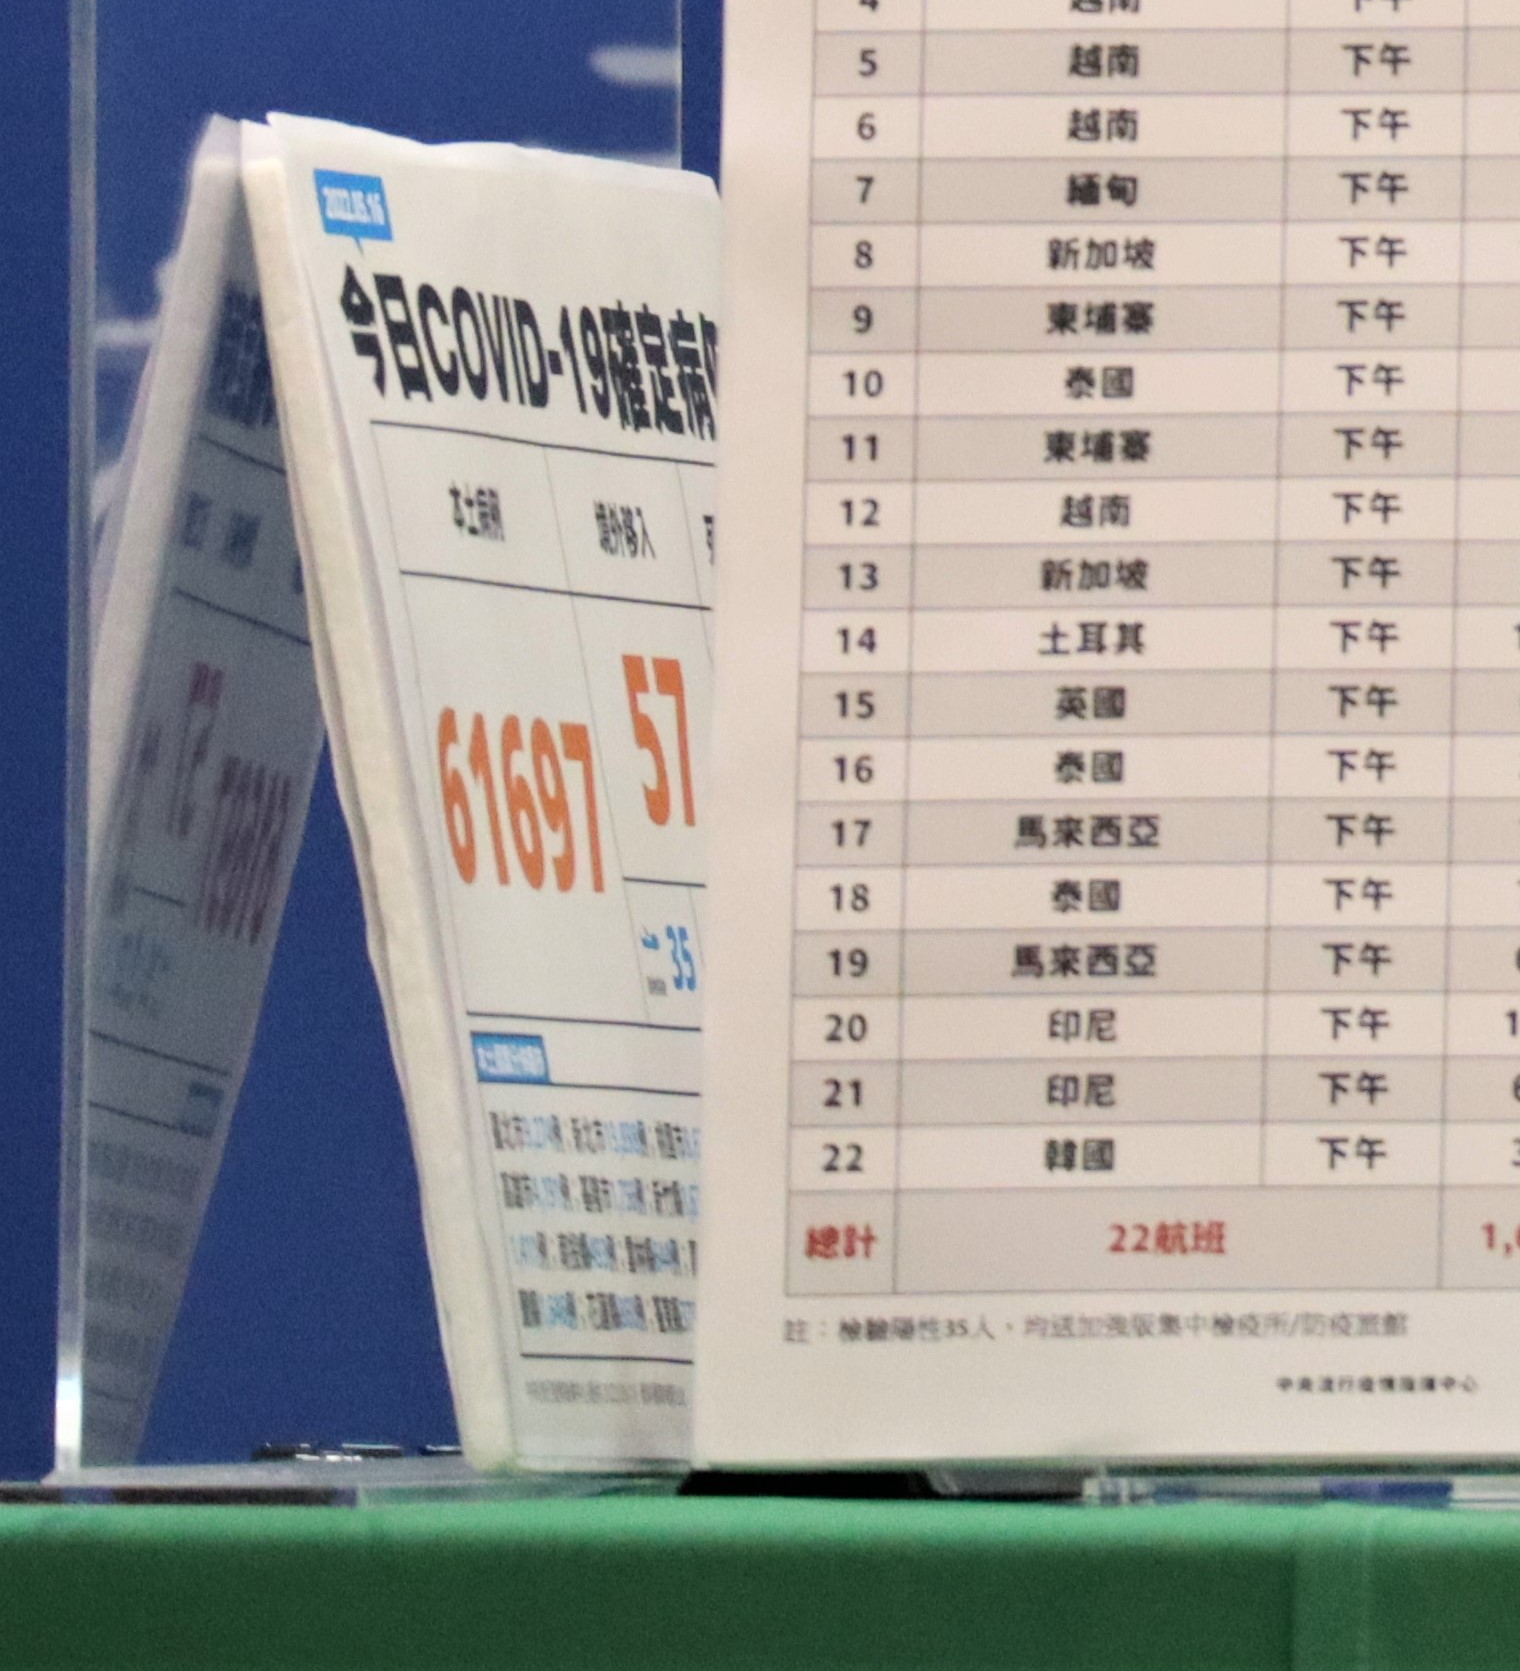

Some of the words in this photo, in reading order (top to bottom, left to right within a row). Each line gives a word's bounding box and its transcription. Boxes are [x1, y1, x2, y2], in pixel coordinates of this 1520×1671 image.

[859, 48, 879, 78] 5
[1068, 43, 1140, 78] 越南
[1342, 42, 1411, 77] 下午
[856, 111, 877, 142] 6
[1067, 108, 1139, 143] 越南
[1341, 107, 1410, 140] 下午
[1340, 170, 1409, 204] 下午
[854, 239, 874, 270] 8
[1047, 237, 1156, 271] 新加坡
[1339, 235, 1407, 268] 下午
[852, 304, 874, 335] 9
[1337, 298, 1406, 332] 下午
[340, 263, 717, 441] 今日COVID-19確定病
[843, 369, 884, 399] 10
[1064, 365, 1134, 400] 泰國
[1336, 363, 1404, 396] 下午
[842, 433, 879, 462] 11
[1334, 426, 1403, 460] 下午
[841, 498, 880, 528] 12
[1060, 493, 1131, 528] 越南
[1333, 491, 1401, 524] 下午
[839, 562, 879, 591] 13
[1041, 558, 1149, 592] 新加坡
[1331, 555, 1401, 589] 下午
[838, 626, 877, 654] 14
[1039, 621, 1145, 656] 土耳其
[1330, 620, 1399, 653] 下午
[835, 690, 876, 720] 15
[1055, 685, 1127, 720] 英國
[1328, 684, 1398, 718] 下午
[437, 707, 605, 894] 61697
[621, 654, 696, 827] 57
[834, 754, 874, 784] 16
[1054, 750, 1125, 785] 泰國
[1327, 748, 1396, 782] 下午
[832, 819, 872, 848] 17
[1015, 814, 1159, 849] 馬來西亞
[1325, 813, 1395, 847] 下午
[830, 883, 870, 913] 18
[1051, 879, 1121, 914] 泰國
[1325, 877, 1393, 911] 下午
[828, 948, 869, 978] 19
[1011, 943, 1156, 979] 馬來西亞
[1322, 942, 1392, 976] 下午
[825, 1013, 868, 1043] 20
[1047, 1008, 1117, 1043] 印尼
[1321, 1006, 1390, 1040] 下午
[823, 1078, 862, 1109] 21
[1046, 1073, 1116, 1109] 印尼
[1319, 1071, 1389, 1105] 下午
[822, 1143, 863, 1173] 22
[1044, 1138, 1116, 1172] 韓國
[1318, 1136, 1387, 1170] 下午
[804, 1224, 877, 1260] 總計
[1109, 1220, 1226, 1255] 22航班
